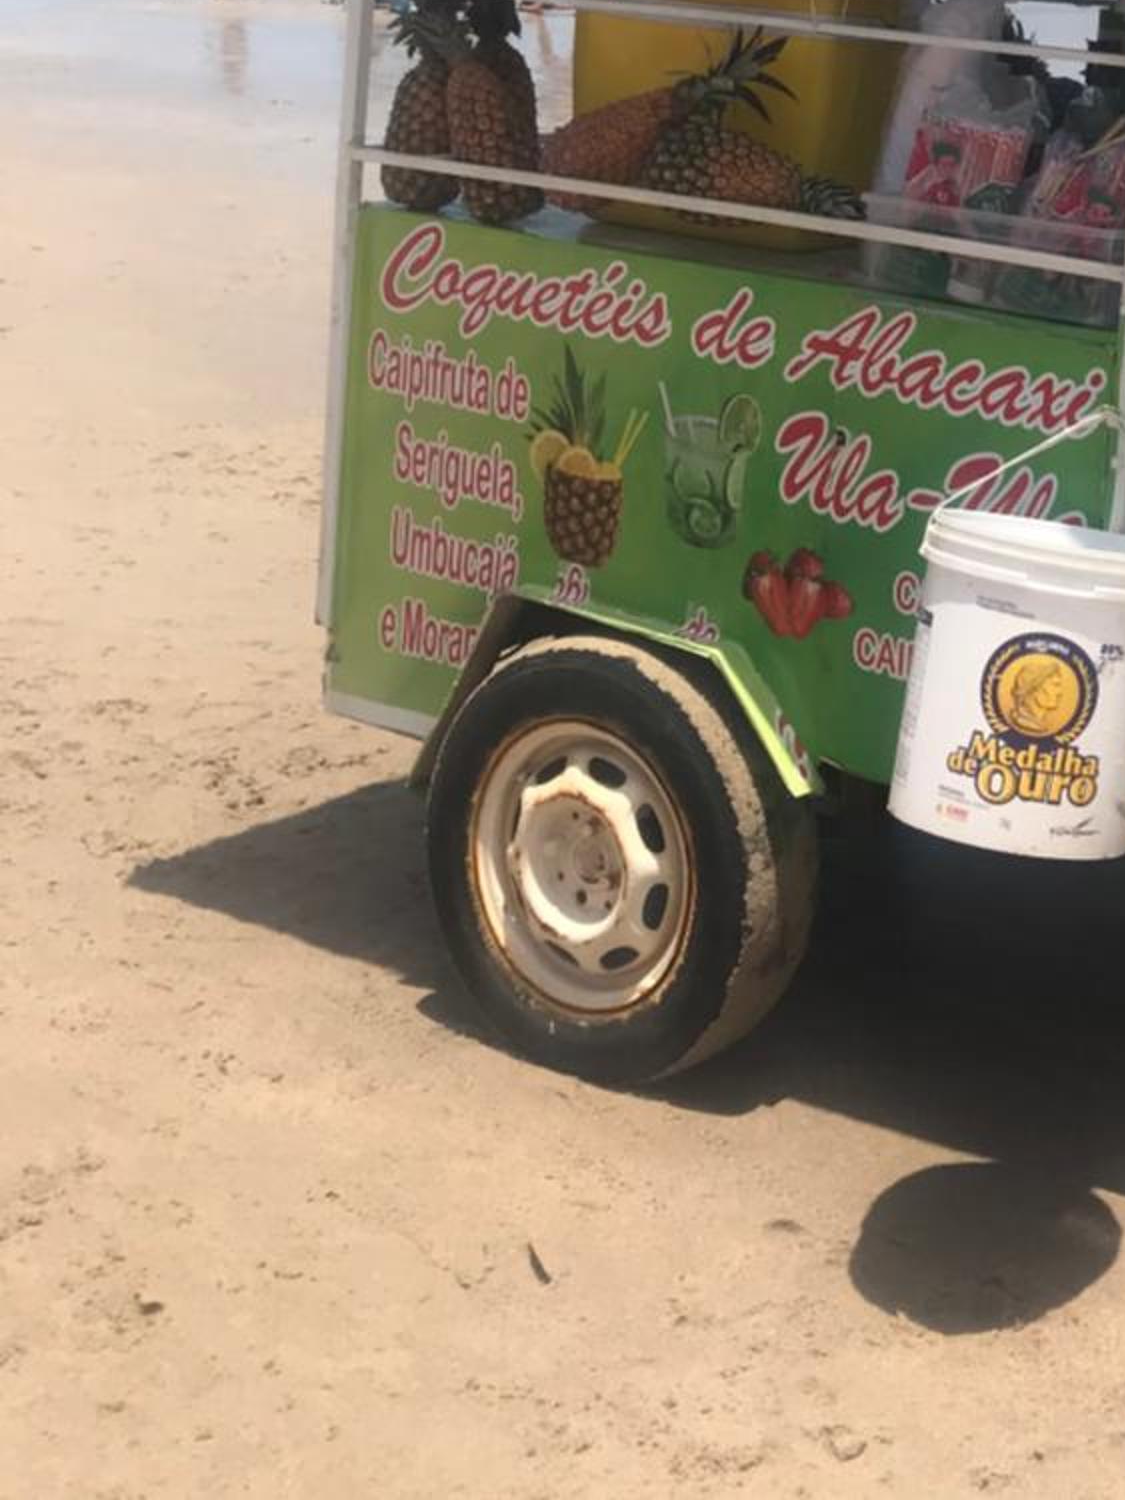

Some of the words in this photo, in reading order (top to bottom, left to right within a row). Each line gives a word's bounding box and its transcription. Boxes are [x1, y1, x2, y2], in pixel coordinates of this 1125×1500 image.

[380, 220, 671, 347] Coquetéis
[692, 286, 775, 368] de
[784, 305, 1107, 438] Abacaxi
[369, 330, 489, 414] Caipifruta
[494, 357, 530, 424] de
[394, 420, 523, 523] Seriguela,
[379, 604, 397, 650] e
[946, 745, 979, 775] de
[974, 763, 1098, 808] Ouro
[968, 730, 1099, 777] Medalha
